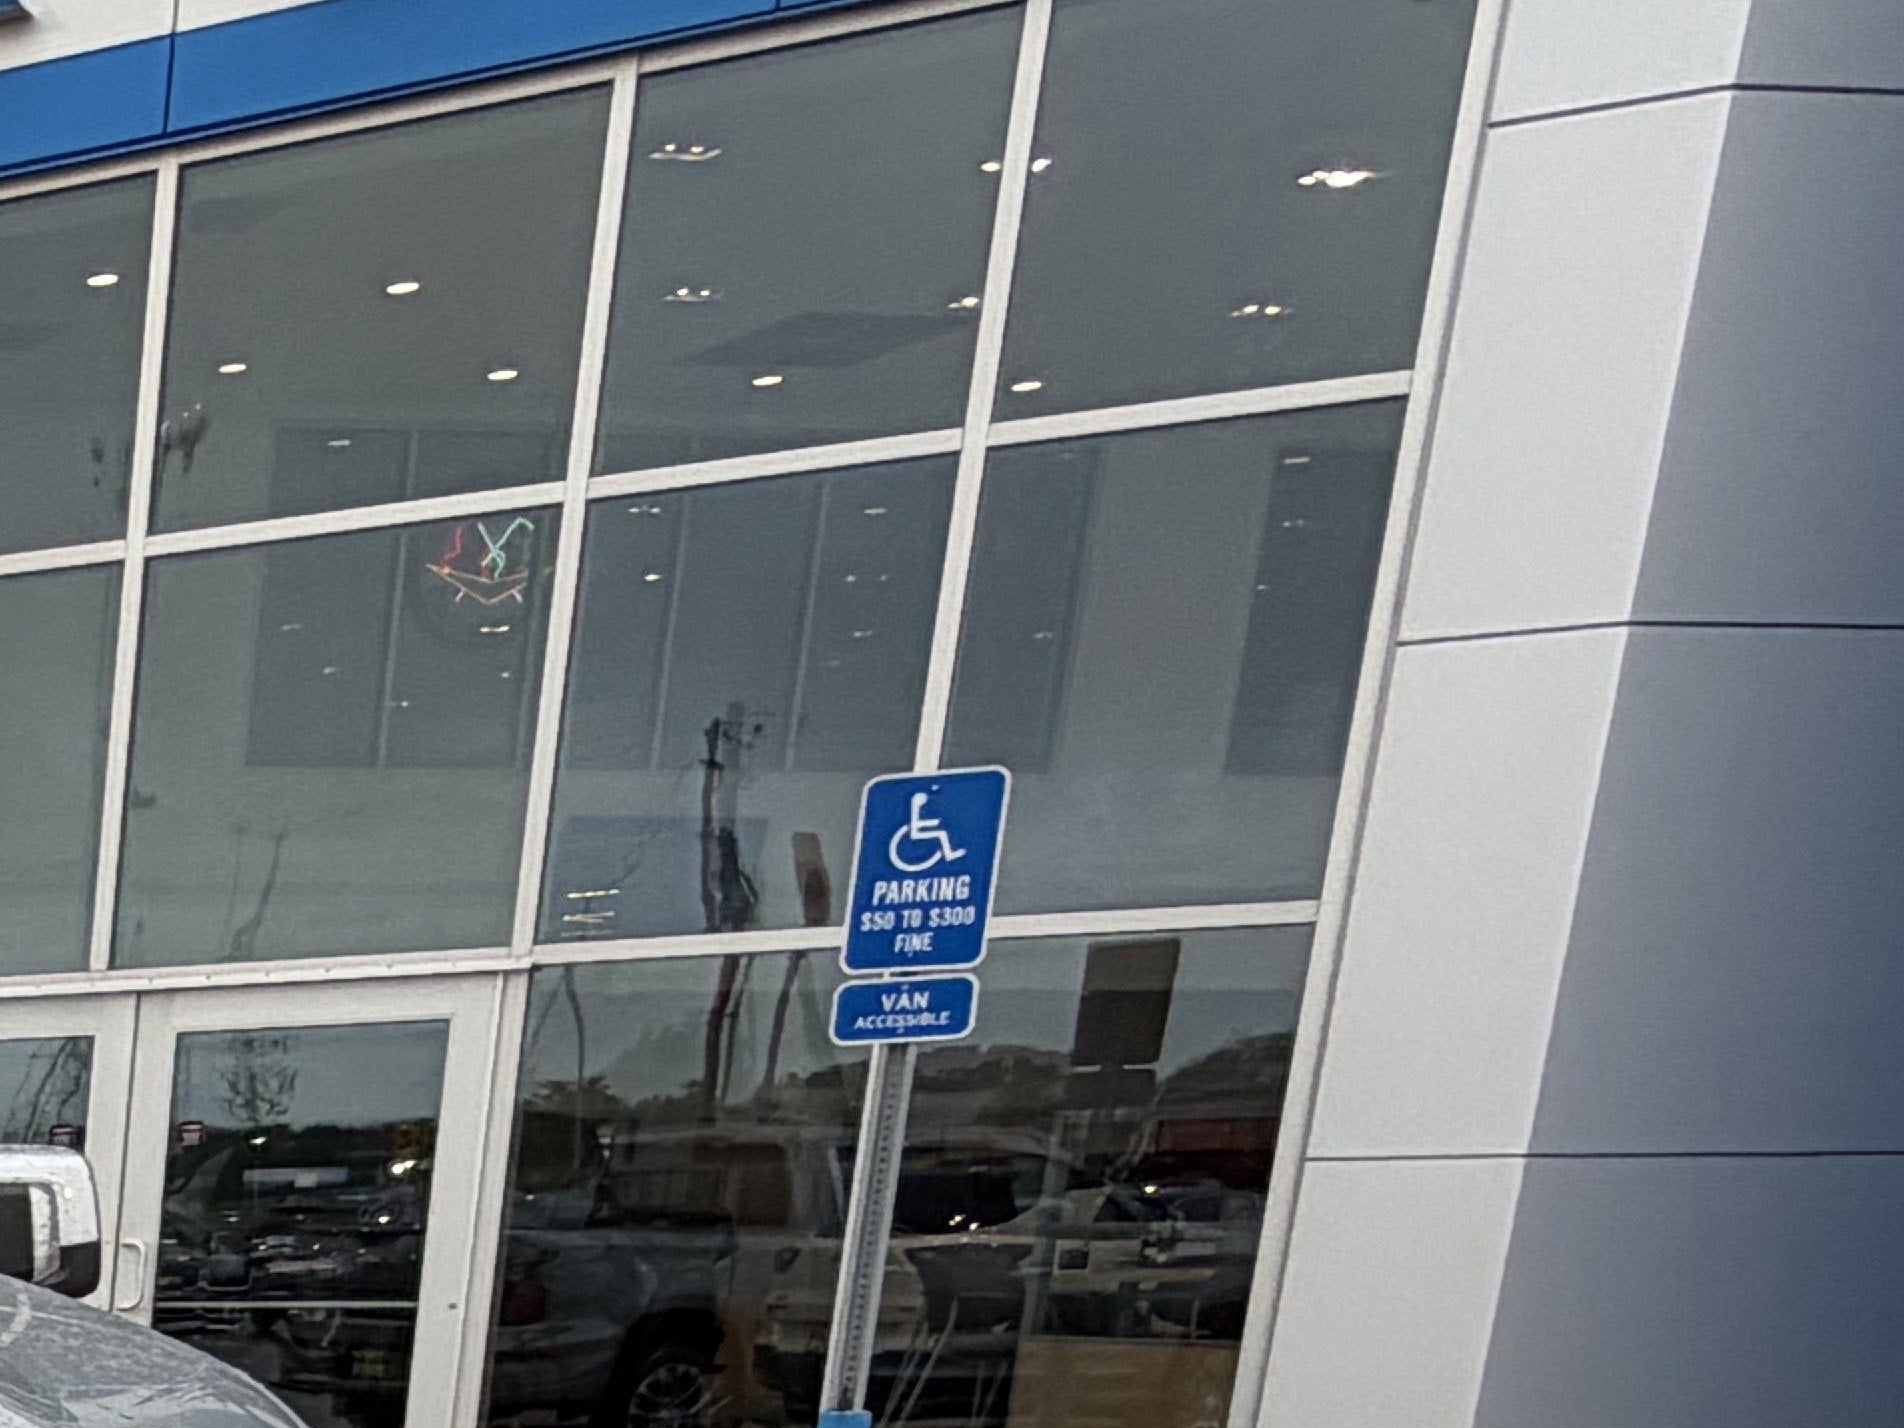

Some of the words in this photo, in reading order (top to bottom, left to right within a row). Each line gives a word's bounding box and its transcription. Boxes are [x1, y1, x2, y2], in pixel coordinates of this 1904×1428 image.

[872, 874, 971, 907] PARKING
[860, 910, 895, 932] $50
[902, 908, 923, 929] TO
[928, 905, 975, 928] $300
[894, 931, 934, 954] FINE
[880, 991, 929, 1012] VAN
[853, 1010, 951, 1030] ACCESSIBLE
